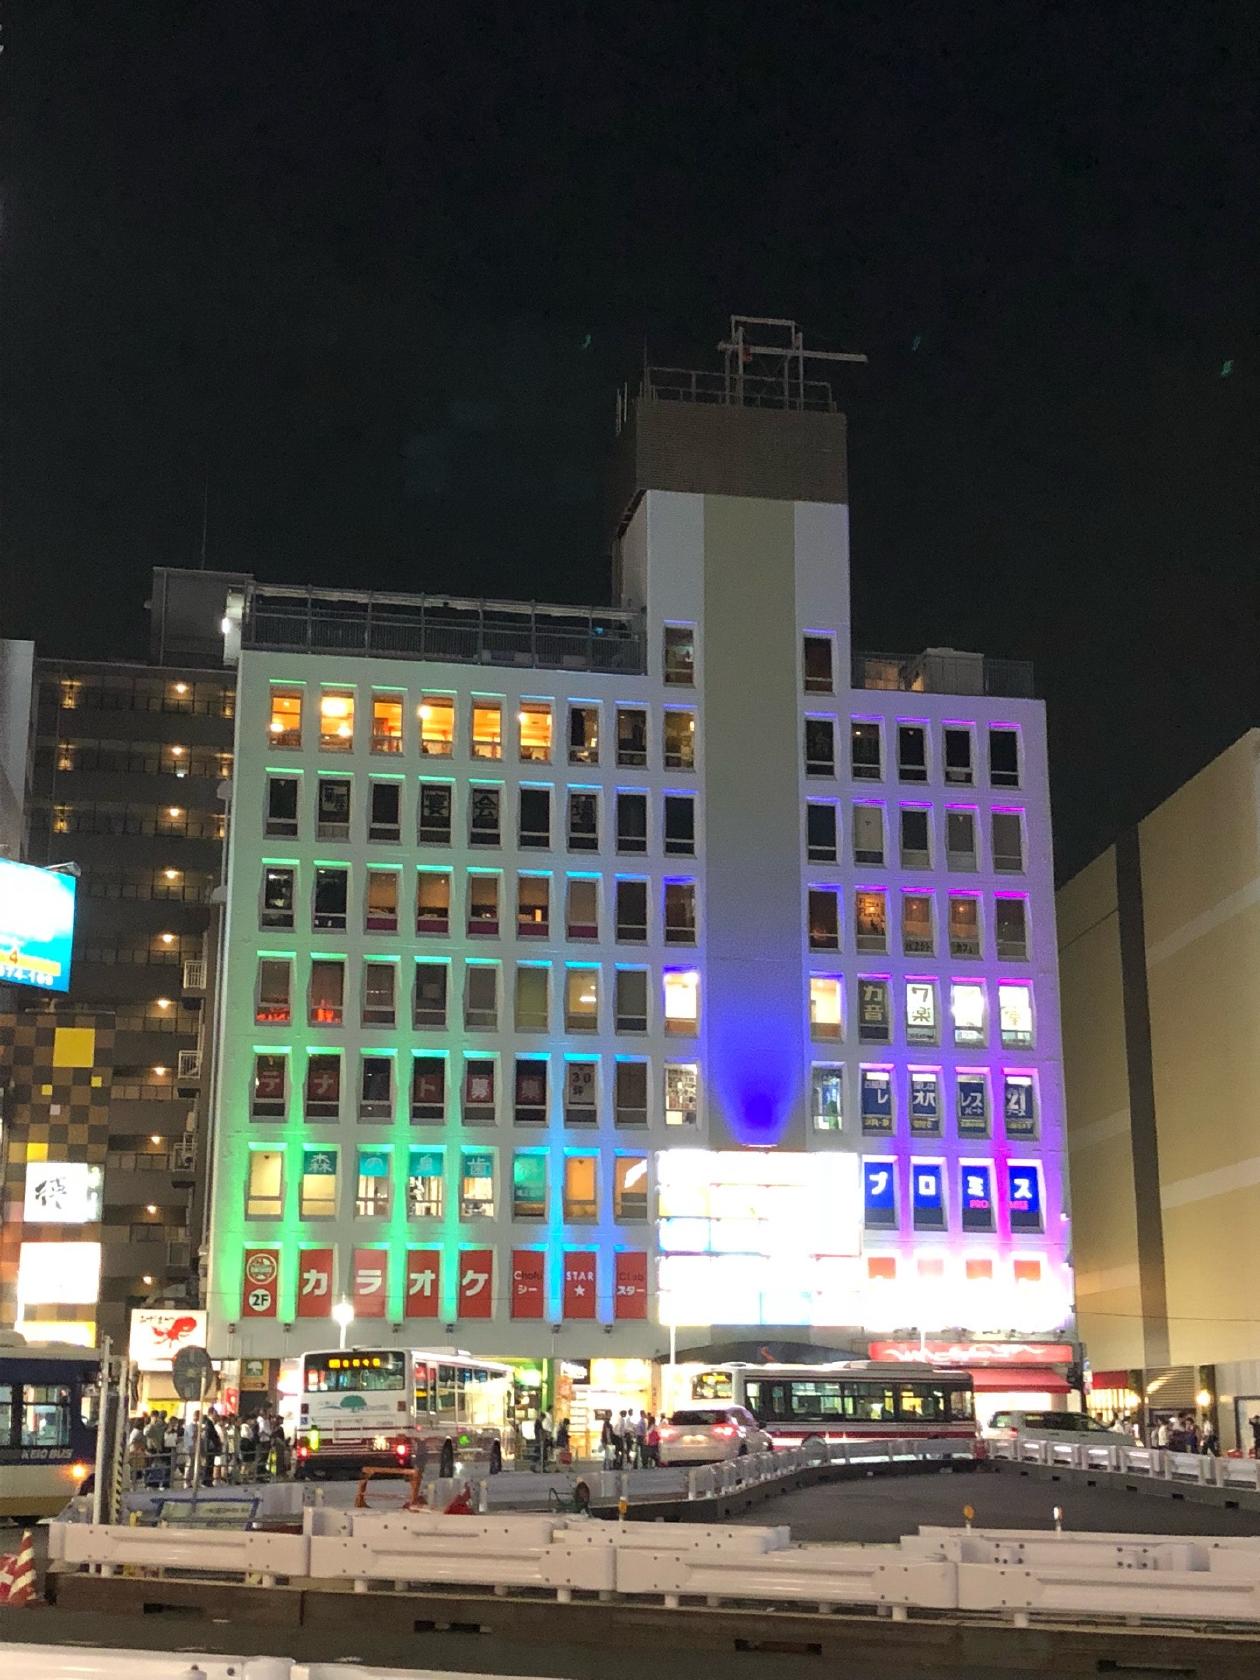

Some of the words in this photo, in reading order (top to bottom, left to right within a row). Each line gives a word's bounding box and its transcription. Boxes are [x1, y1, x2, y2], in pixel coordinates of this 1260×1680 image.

[566, 1271, 594, 1281] STAR
[251, 1293, 269, 1307] 2F
[21, 1448, 48, 1459] KEIO
[48, 1448, 74, 1459] BUS
